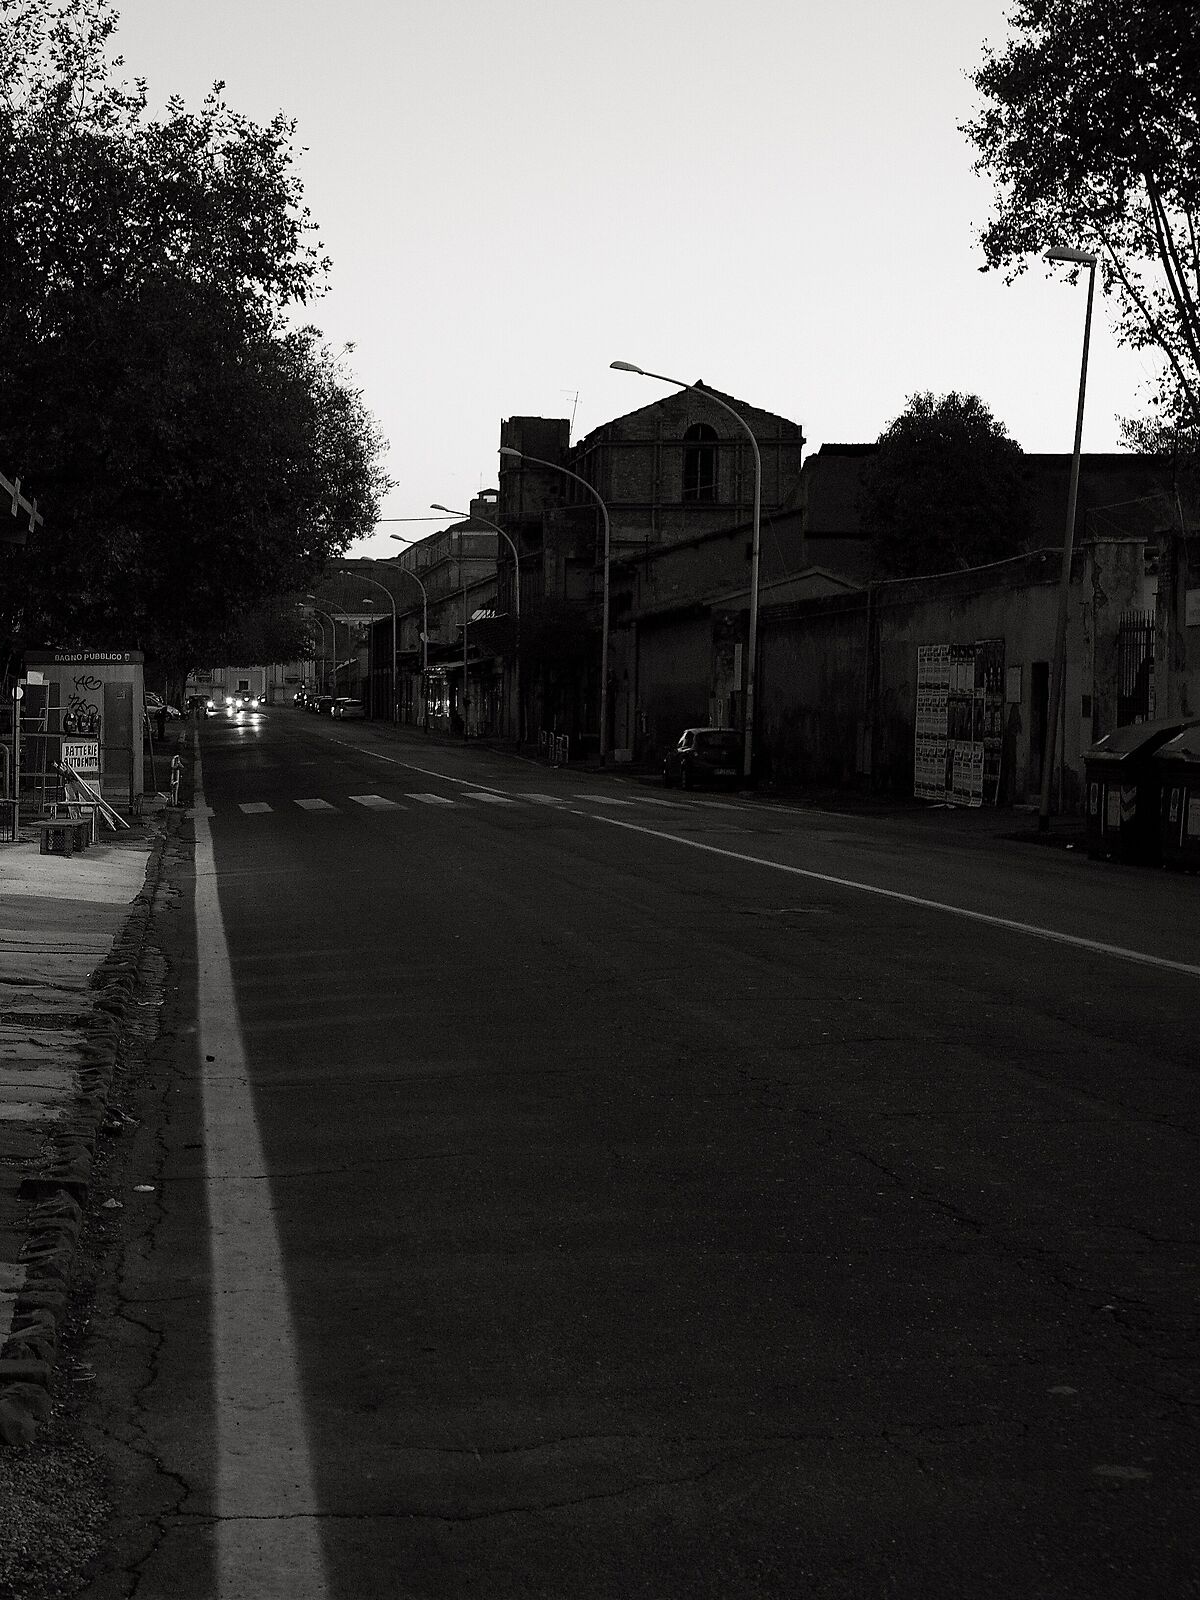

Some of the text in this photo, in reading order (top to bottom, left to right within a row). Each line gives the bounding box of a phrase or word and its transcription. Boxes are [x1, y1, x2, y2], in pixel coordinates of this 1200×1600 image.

[55, 653, 122, 661] BAGNO PUBBLICO
[65, 744, 98, 757] BATTERIE
